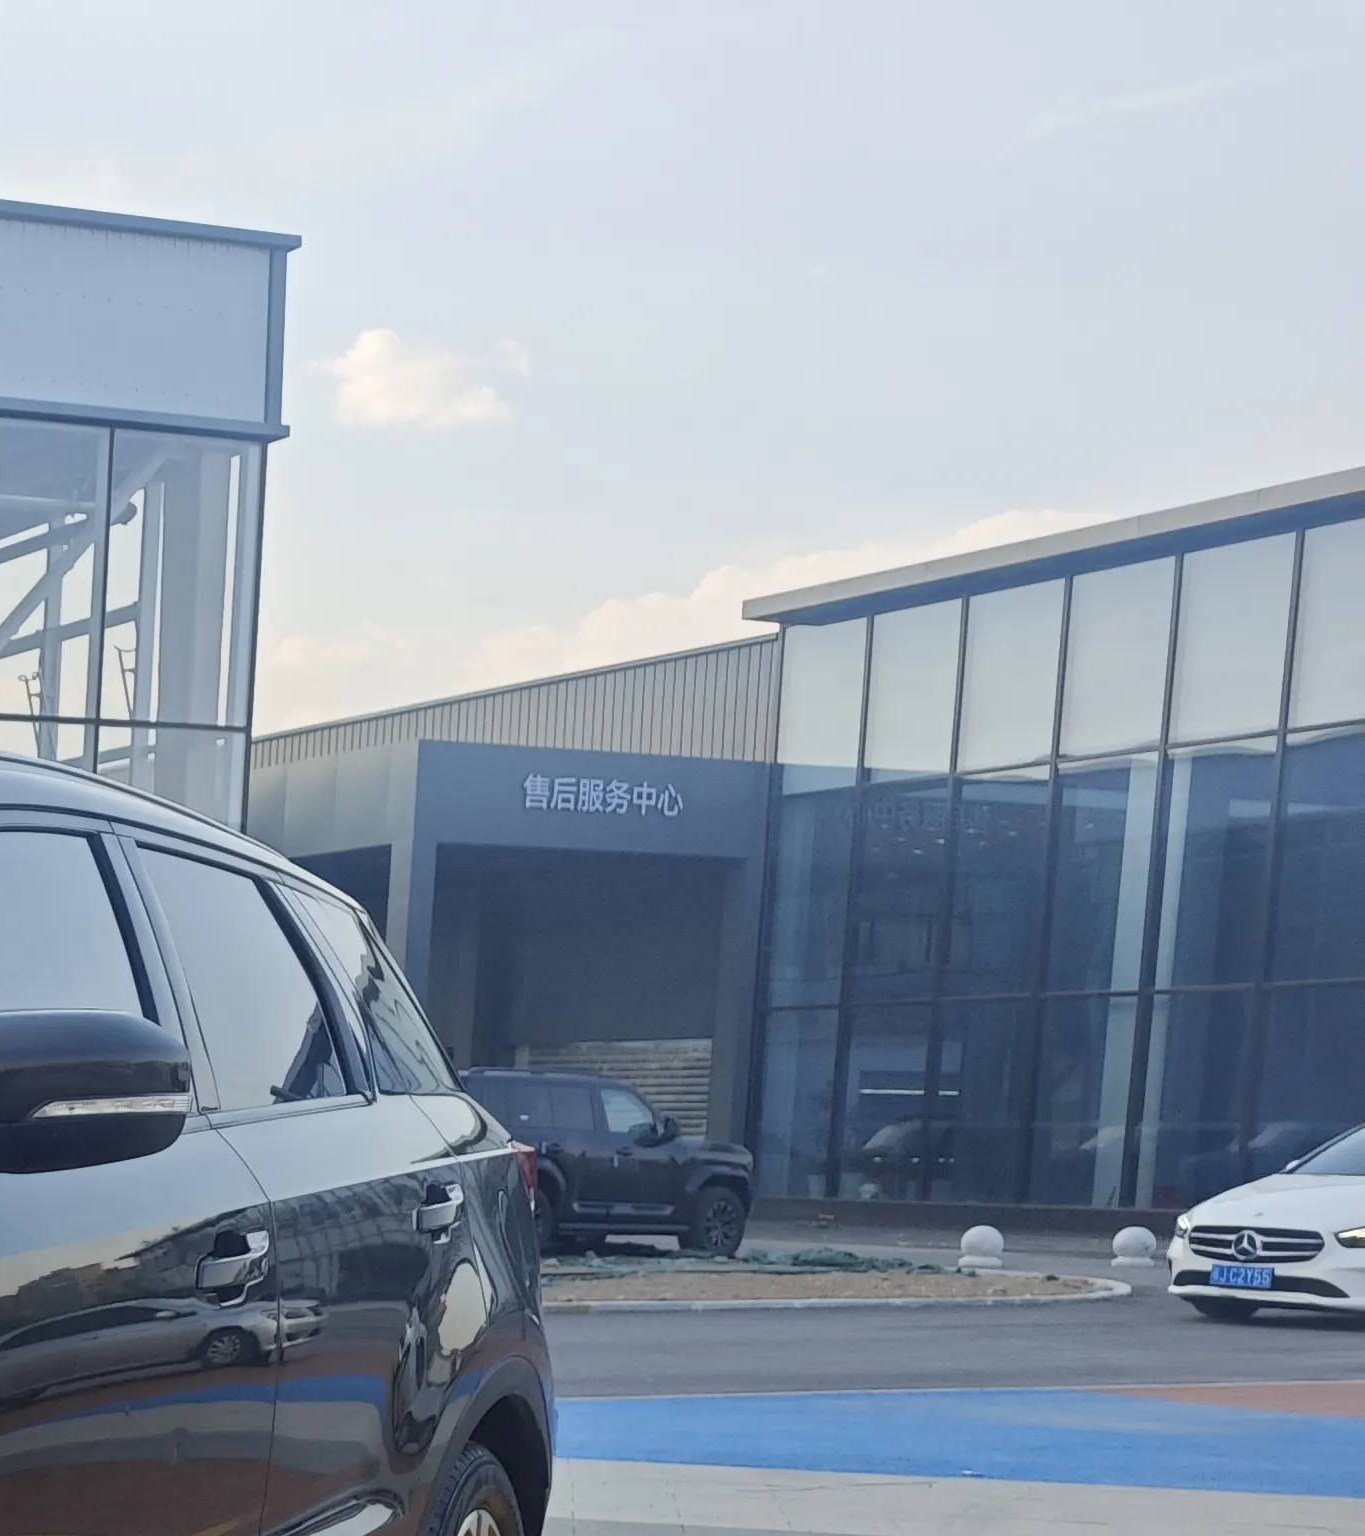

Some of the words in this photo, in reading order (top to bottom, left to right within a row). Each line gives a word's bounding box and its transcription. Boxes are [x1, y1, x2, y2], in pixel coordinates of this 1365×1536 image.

[523, 773, 684, 817] 售后服务中心
